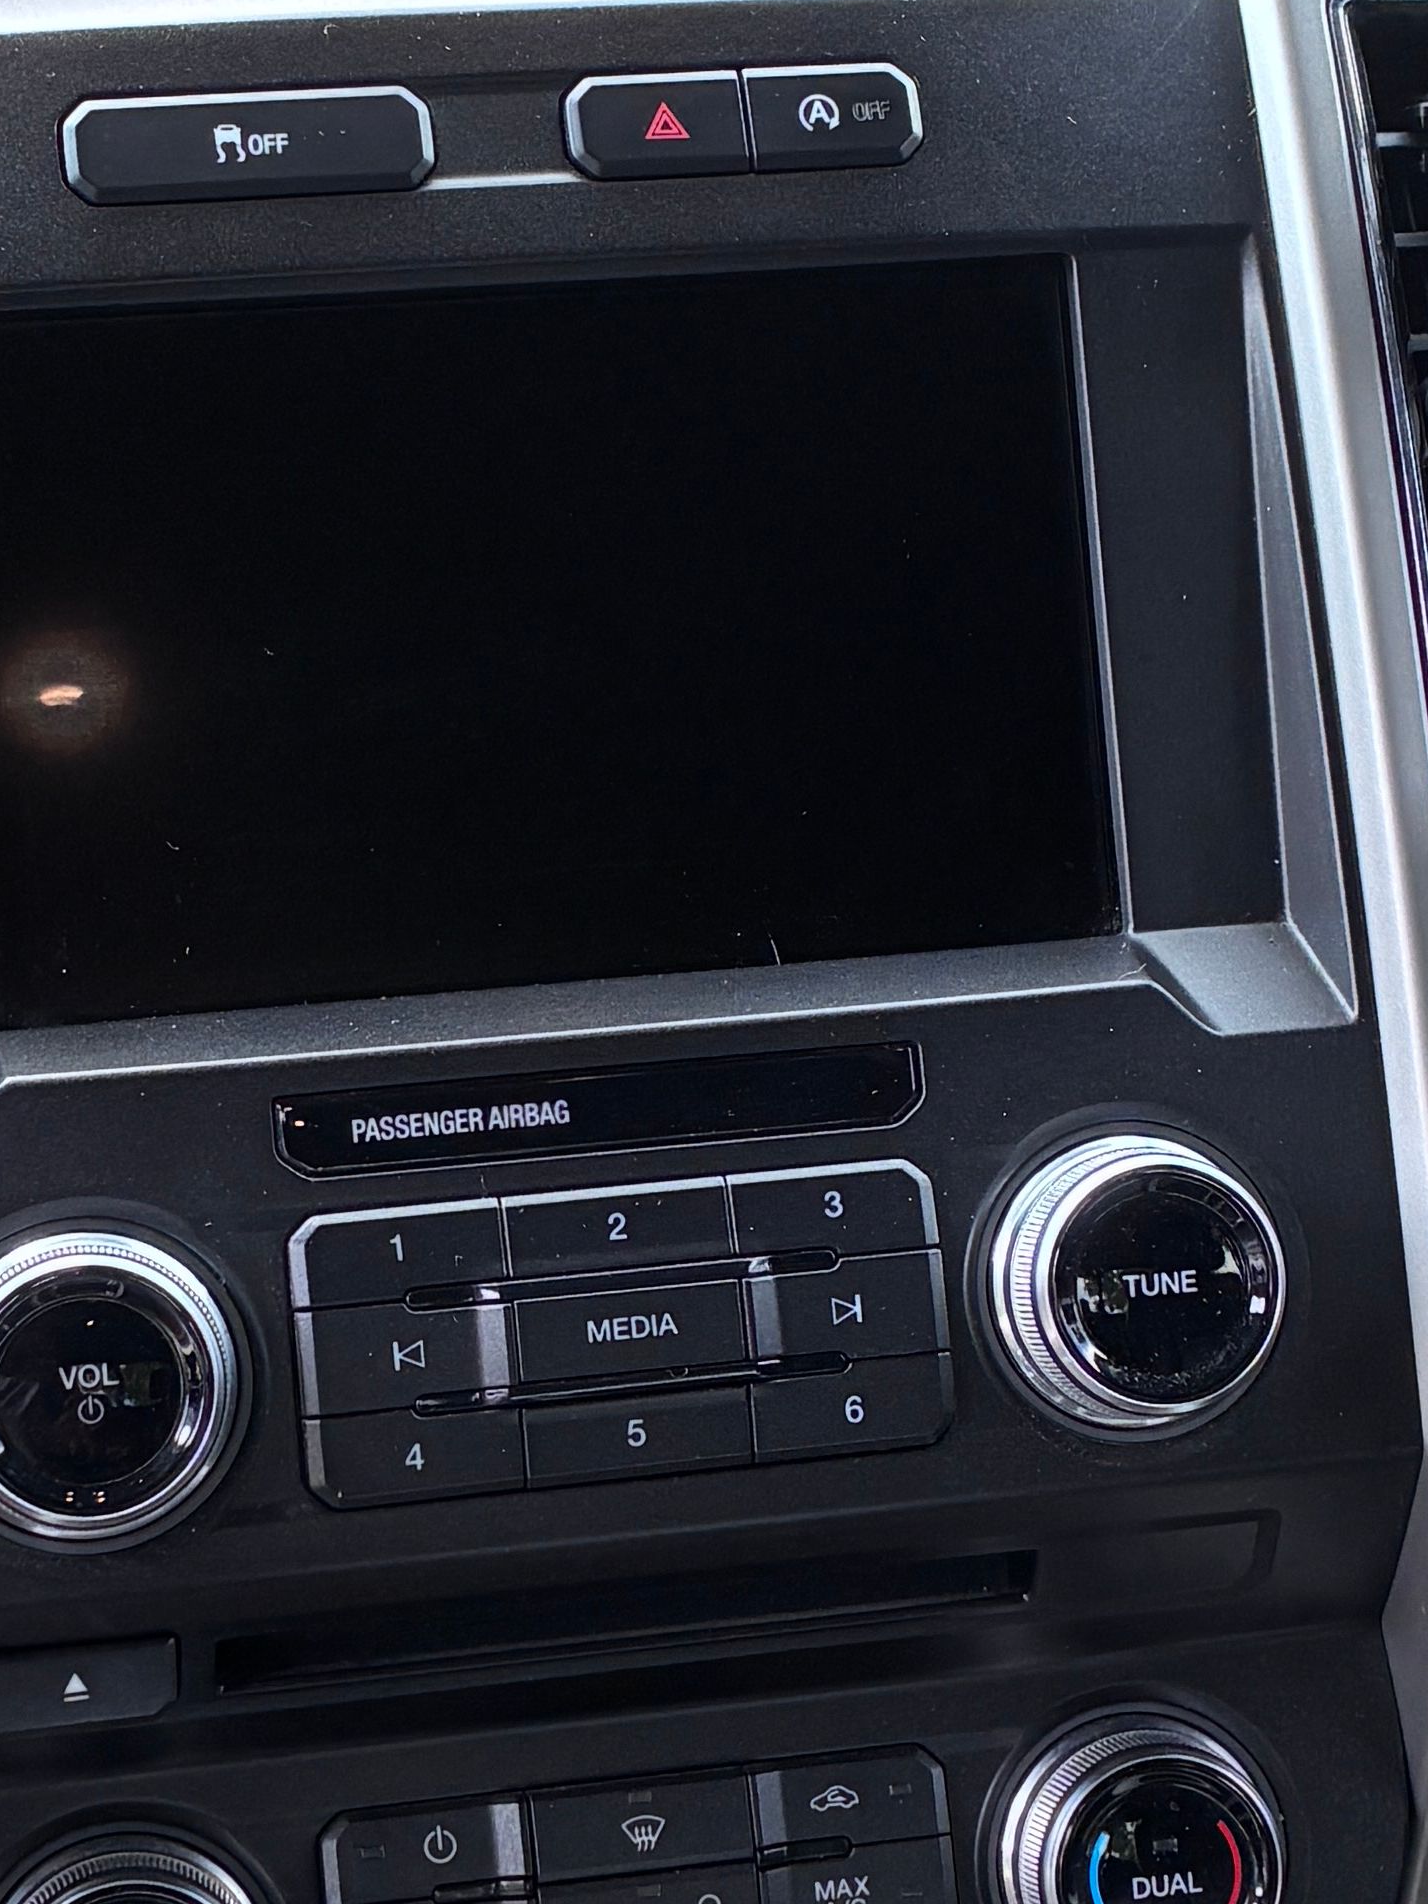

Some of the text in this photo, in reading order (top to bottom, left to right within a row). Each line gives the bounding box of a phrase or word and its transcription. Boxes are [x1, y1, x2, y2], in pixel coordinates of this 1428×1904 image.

[852, 100, 890, 122] OFF
[247, 132, 289, 156] OFF
[350, 1099, 571, 1143] PASSENGER AIRBAG
[824, 1190, 844, 1218] 3
[607, 1212, 628, 1241] 2
[389, 1233, 404, 1262] 1
[1122, 1269, 1199, 1298] TUNE
[586, 1312, 679, 1344] MEDIA
[58, 1362, 121, 1391] VOL
[844, 1395, 864, 1424] 6
[627, 1418, 647, 1447] 5
[405, 1443, 425, 1471] 4
[814, 1875, 870, 1902] MAX
[1132, 1871, 1204, 1900] DUAL
